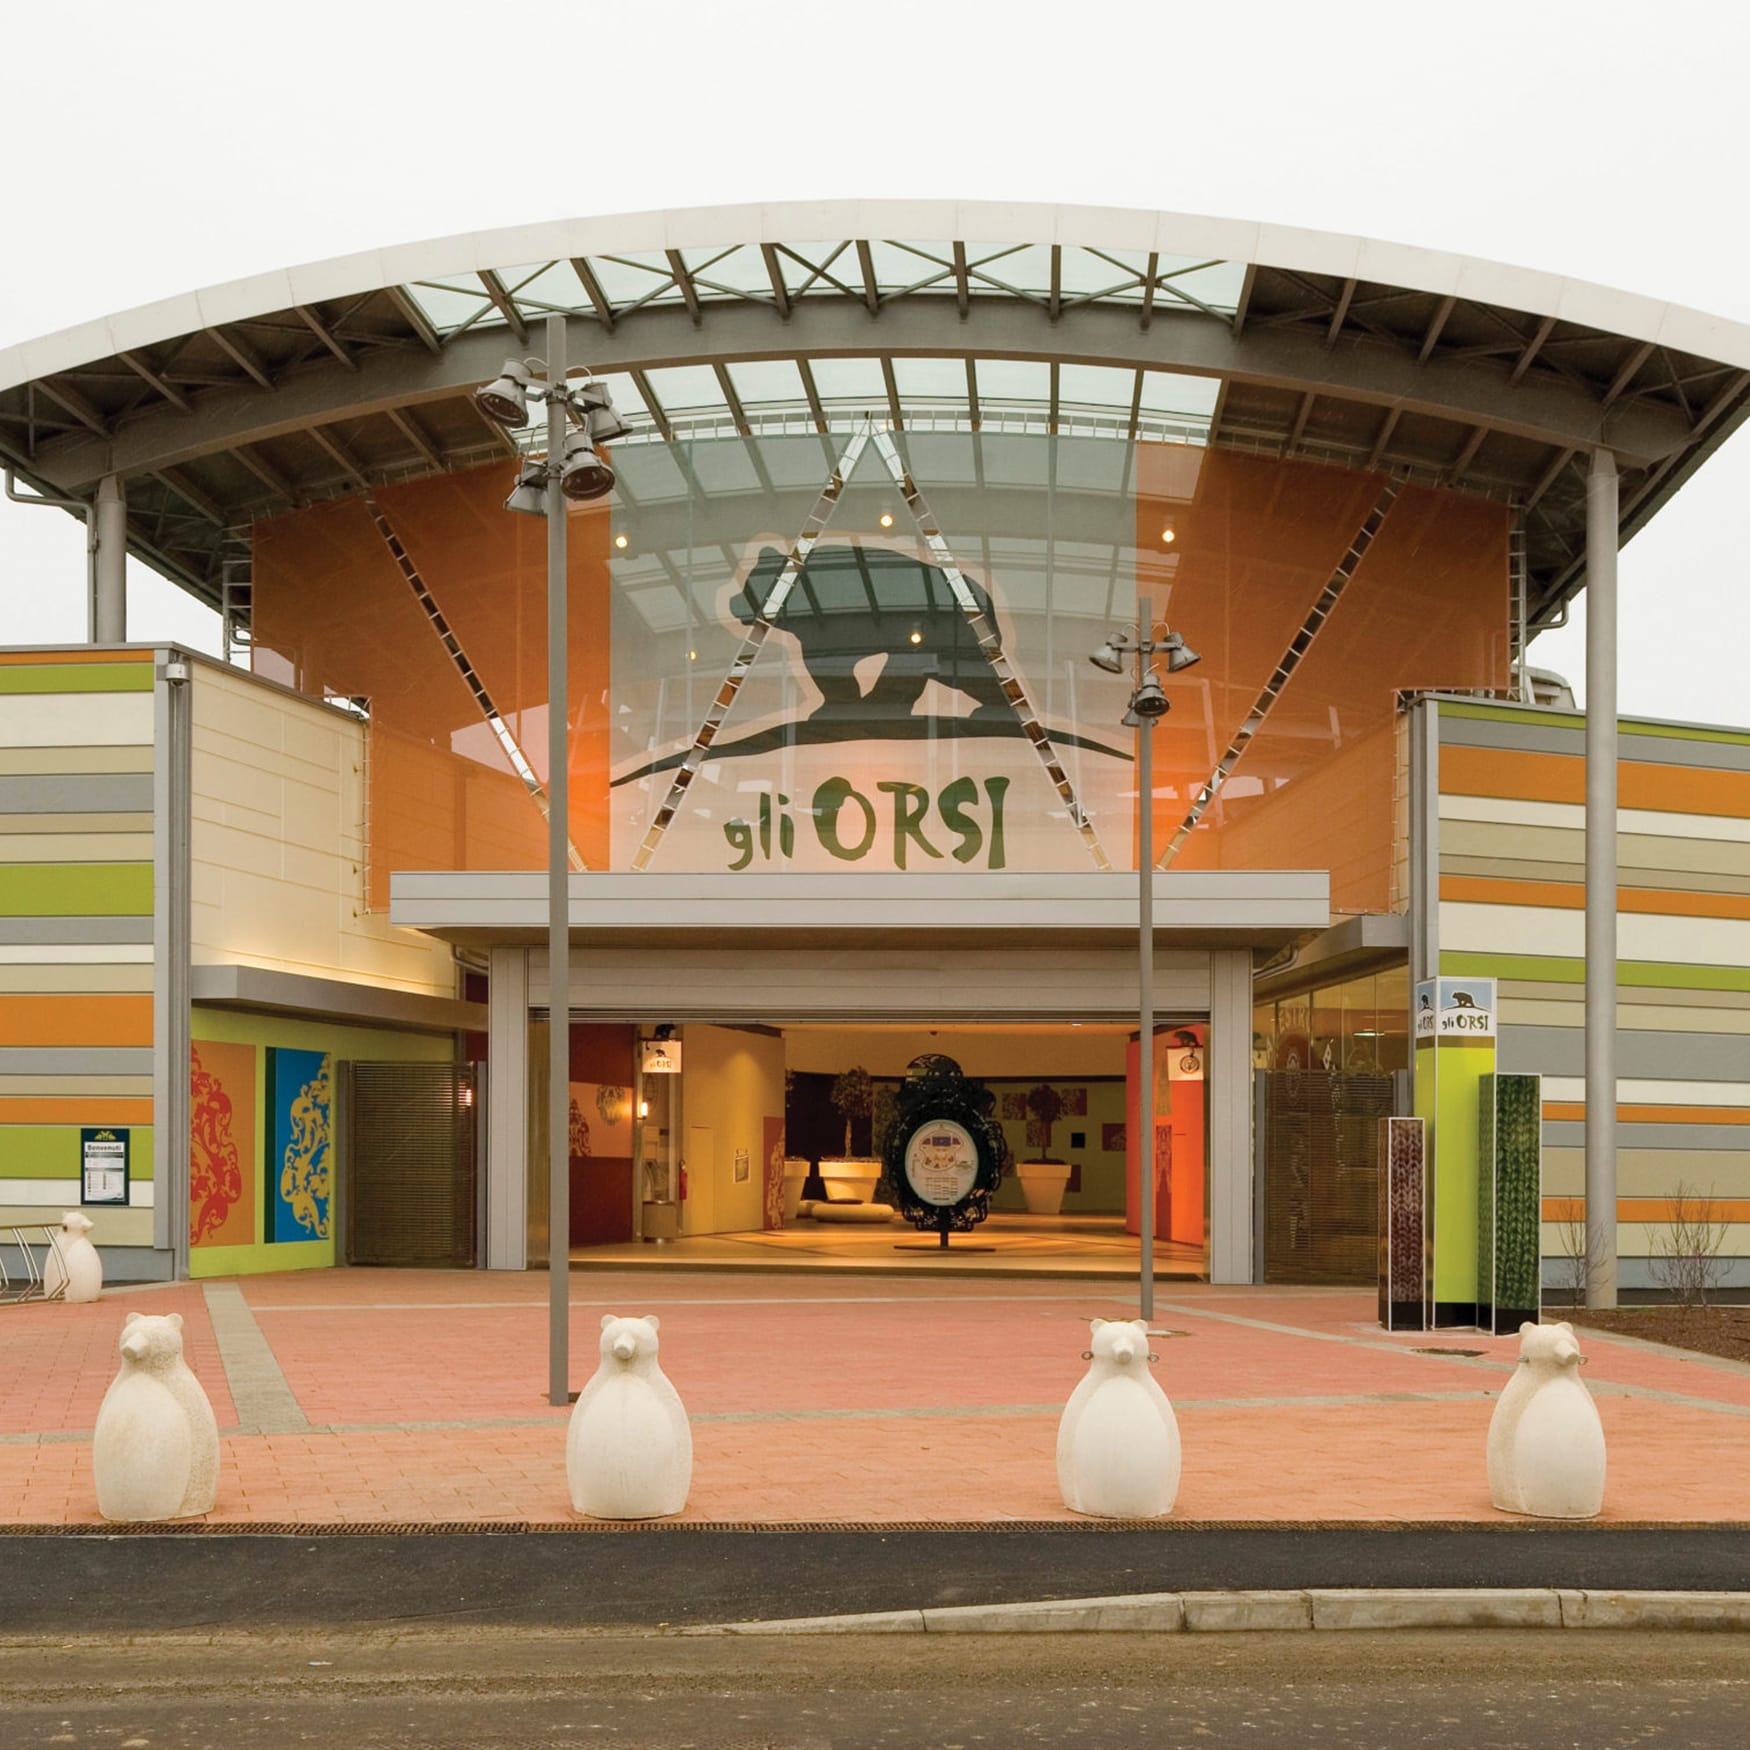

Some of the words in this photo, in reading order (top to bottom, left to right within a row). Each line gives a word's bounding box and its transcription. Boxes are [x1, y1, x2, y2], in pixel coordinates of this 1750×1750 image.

[724, 791, 794, 871] gli
[812, 776, 1010, 871] ORSI
[1441, 1016, 1454, 1030] gli
[1456, 1014, 1489, 1031] ORSI
